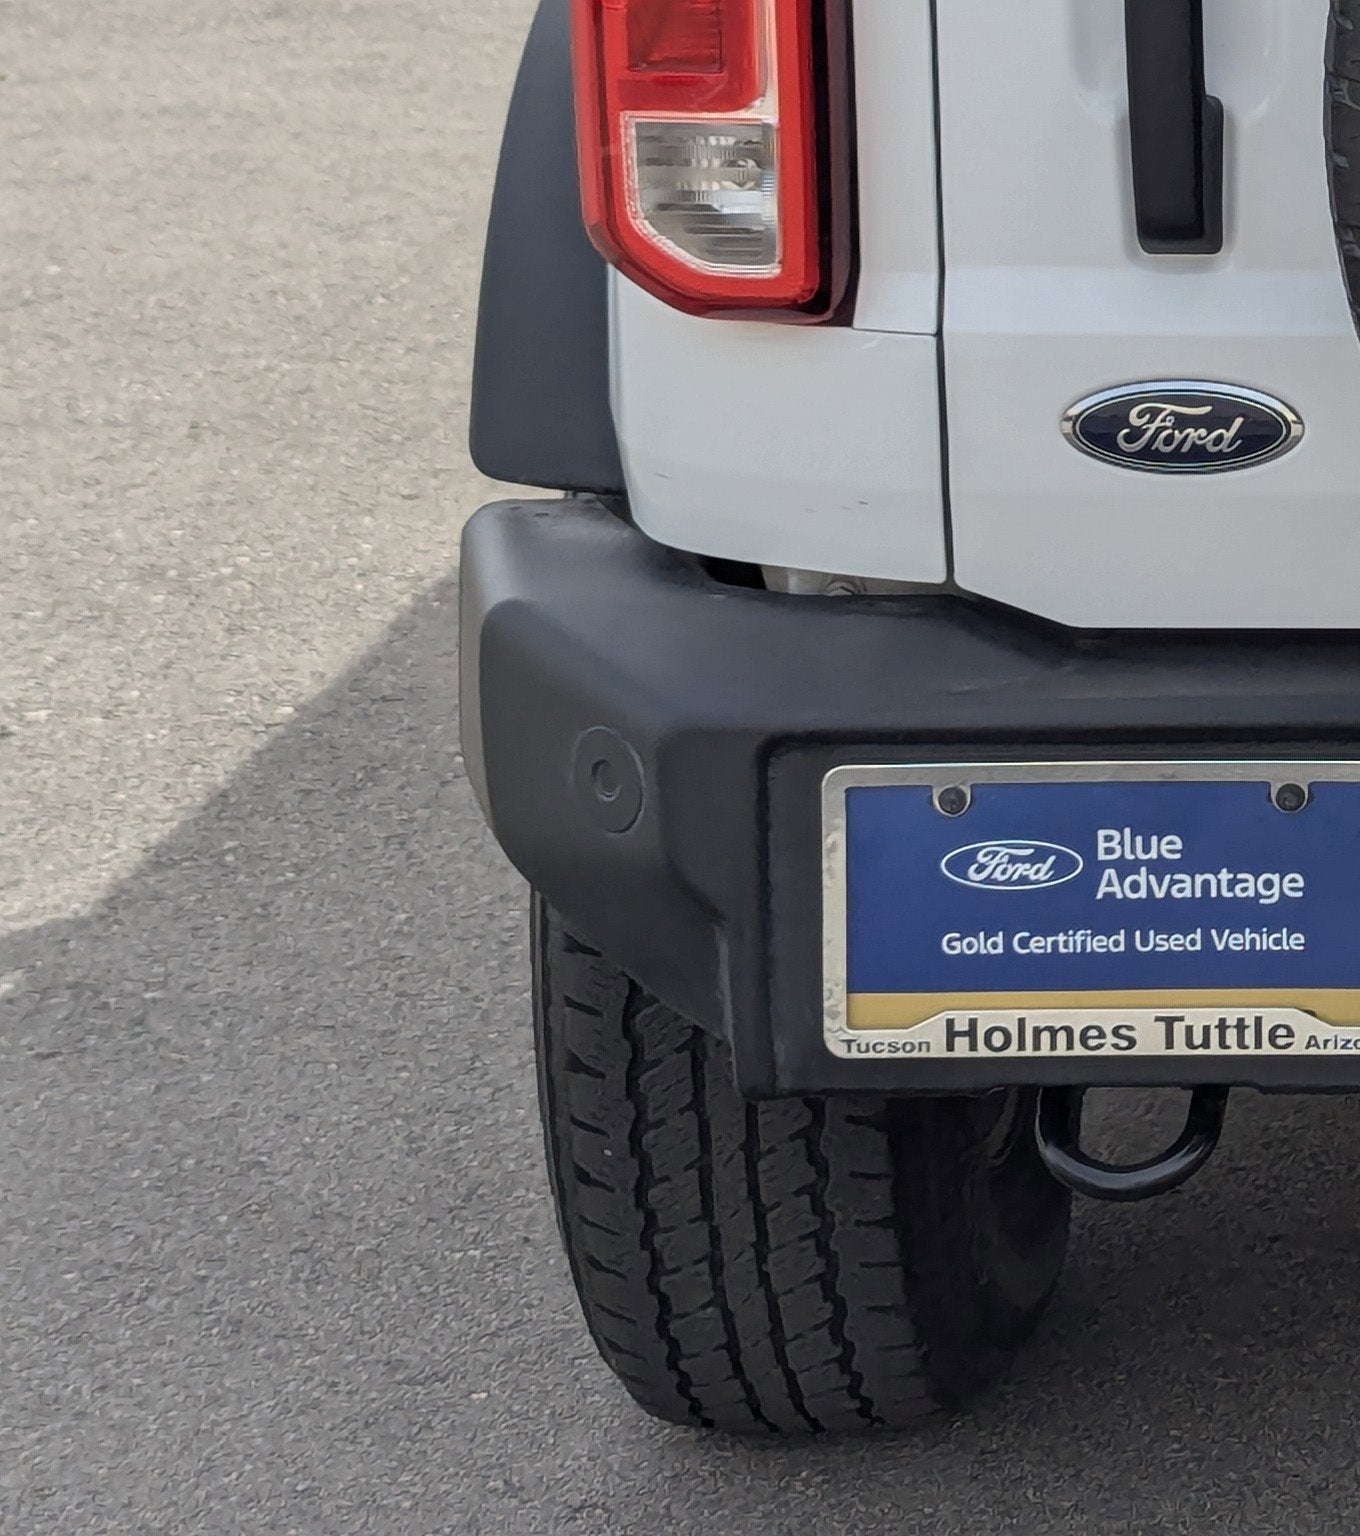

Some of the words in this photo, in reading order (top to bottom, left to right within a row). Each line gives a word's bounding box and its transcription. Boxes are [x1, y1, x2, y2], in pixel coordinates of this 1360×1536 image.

[1116, 402, 1245, 454] Ford
[1096, 827, 1183, 861] Blue
[967, 846, 1057, 883] Ford
[1095, 866, 1305, 905] Advantage
[941, 930, 1004, 955] Gold
[1012, 928, 1126, 955] Certified
[1134, 927, 1202, 953] Used
[1210, 927, 1306, 952] Vehicle
[839, 1038, 932, 1054] Tucson
[945, 1017, 1137, 1053] Holmes
[1154, 1015, 1296, 1050] Tuttle
